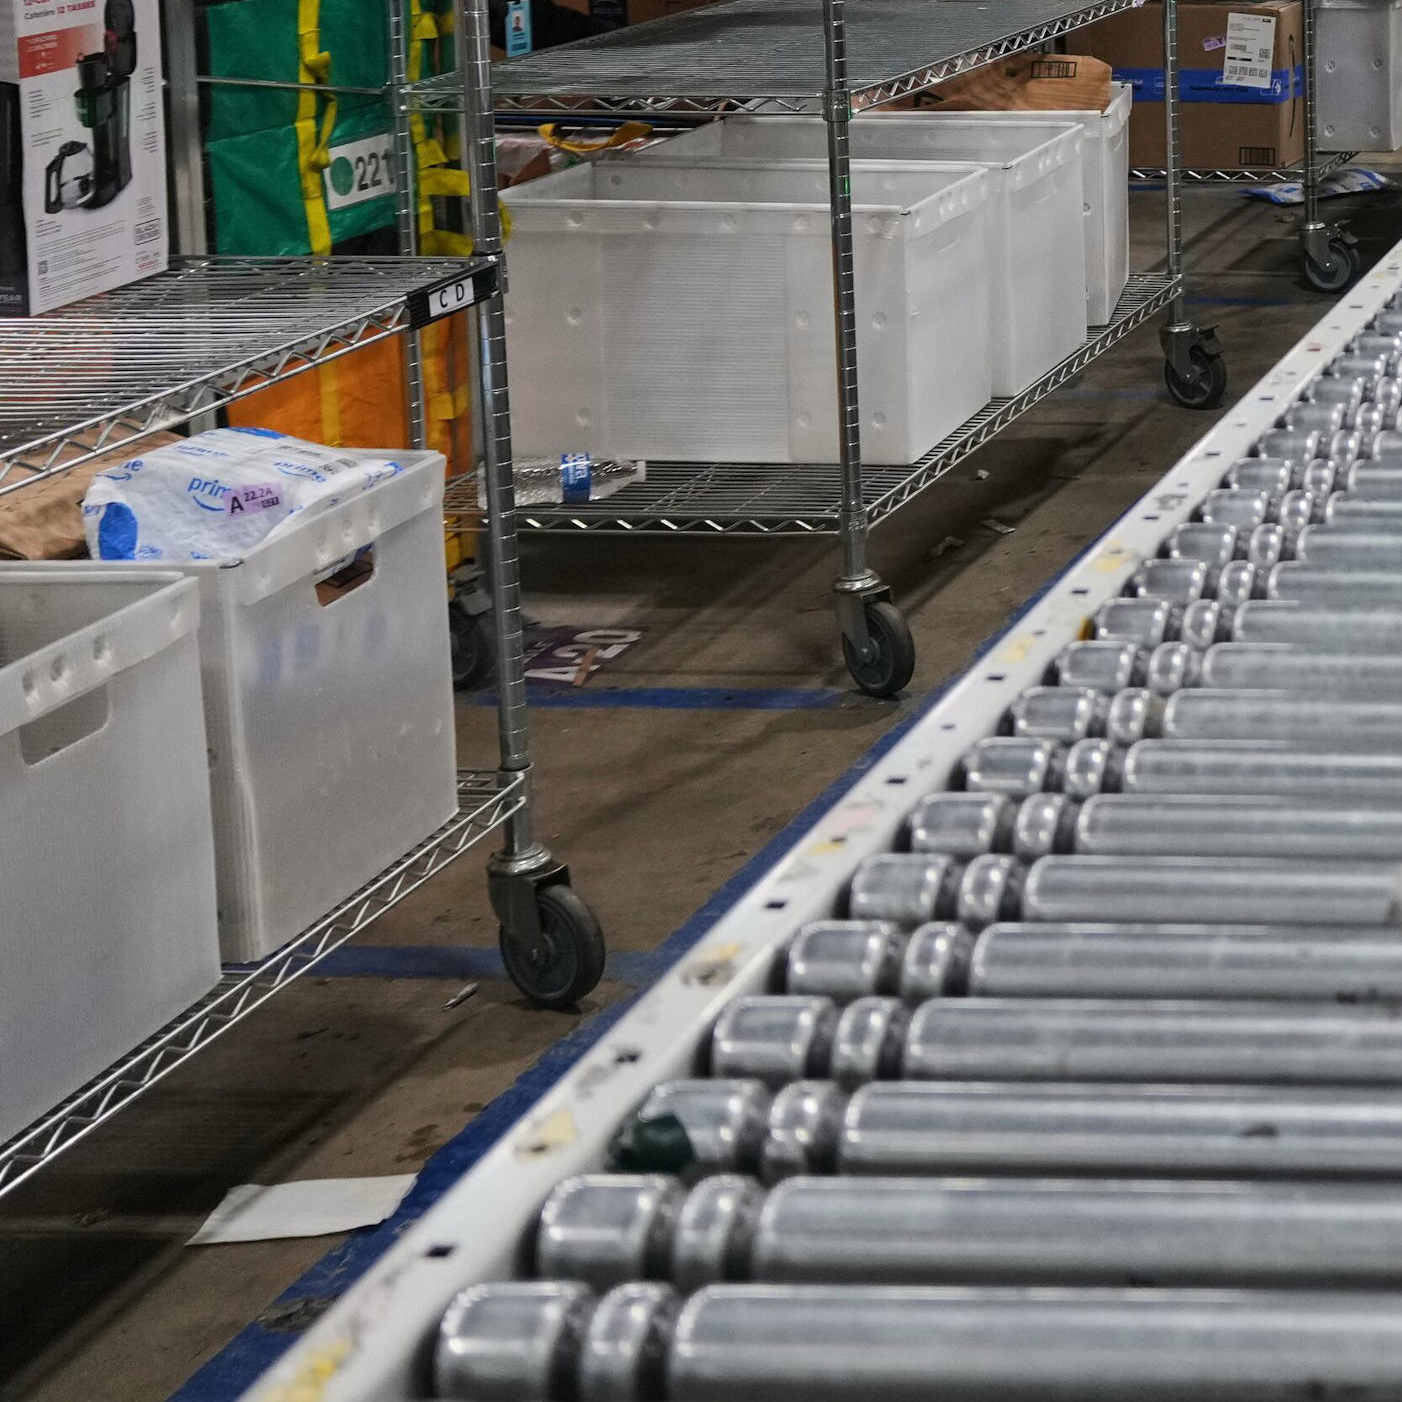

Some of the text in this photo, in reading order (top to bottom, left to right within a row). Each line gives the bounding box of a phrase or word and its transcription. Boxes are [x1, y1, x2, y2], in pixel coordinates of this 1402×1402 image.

[355, 148, 394, 191] 221
[439, 283, 465, 308] C D
[187, 477, 231, 494] prim
[229, 496, 244, 515] A
